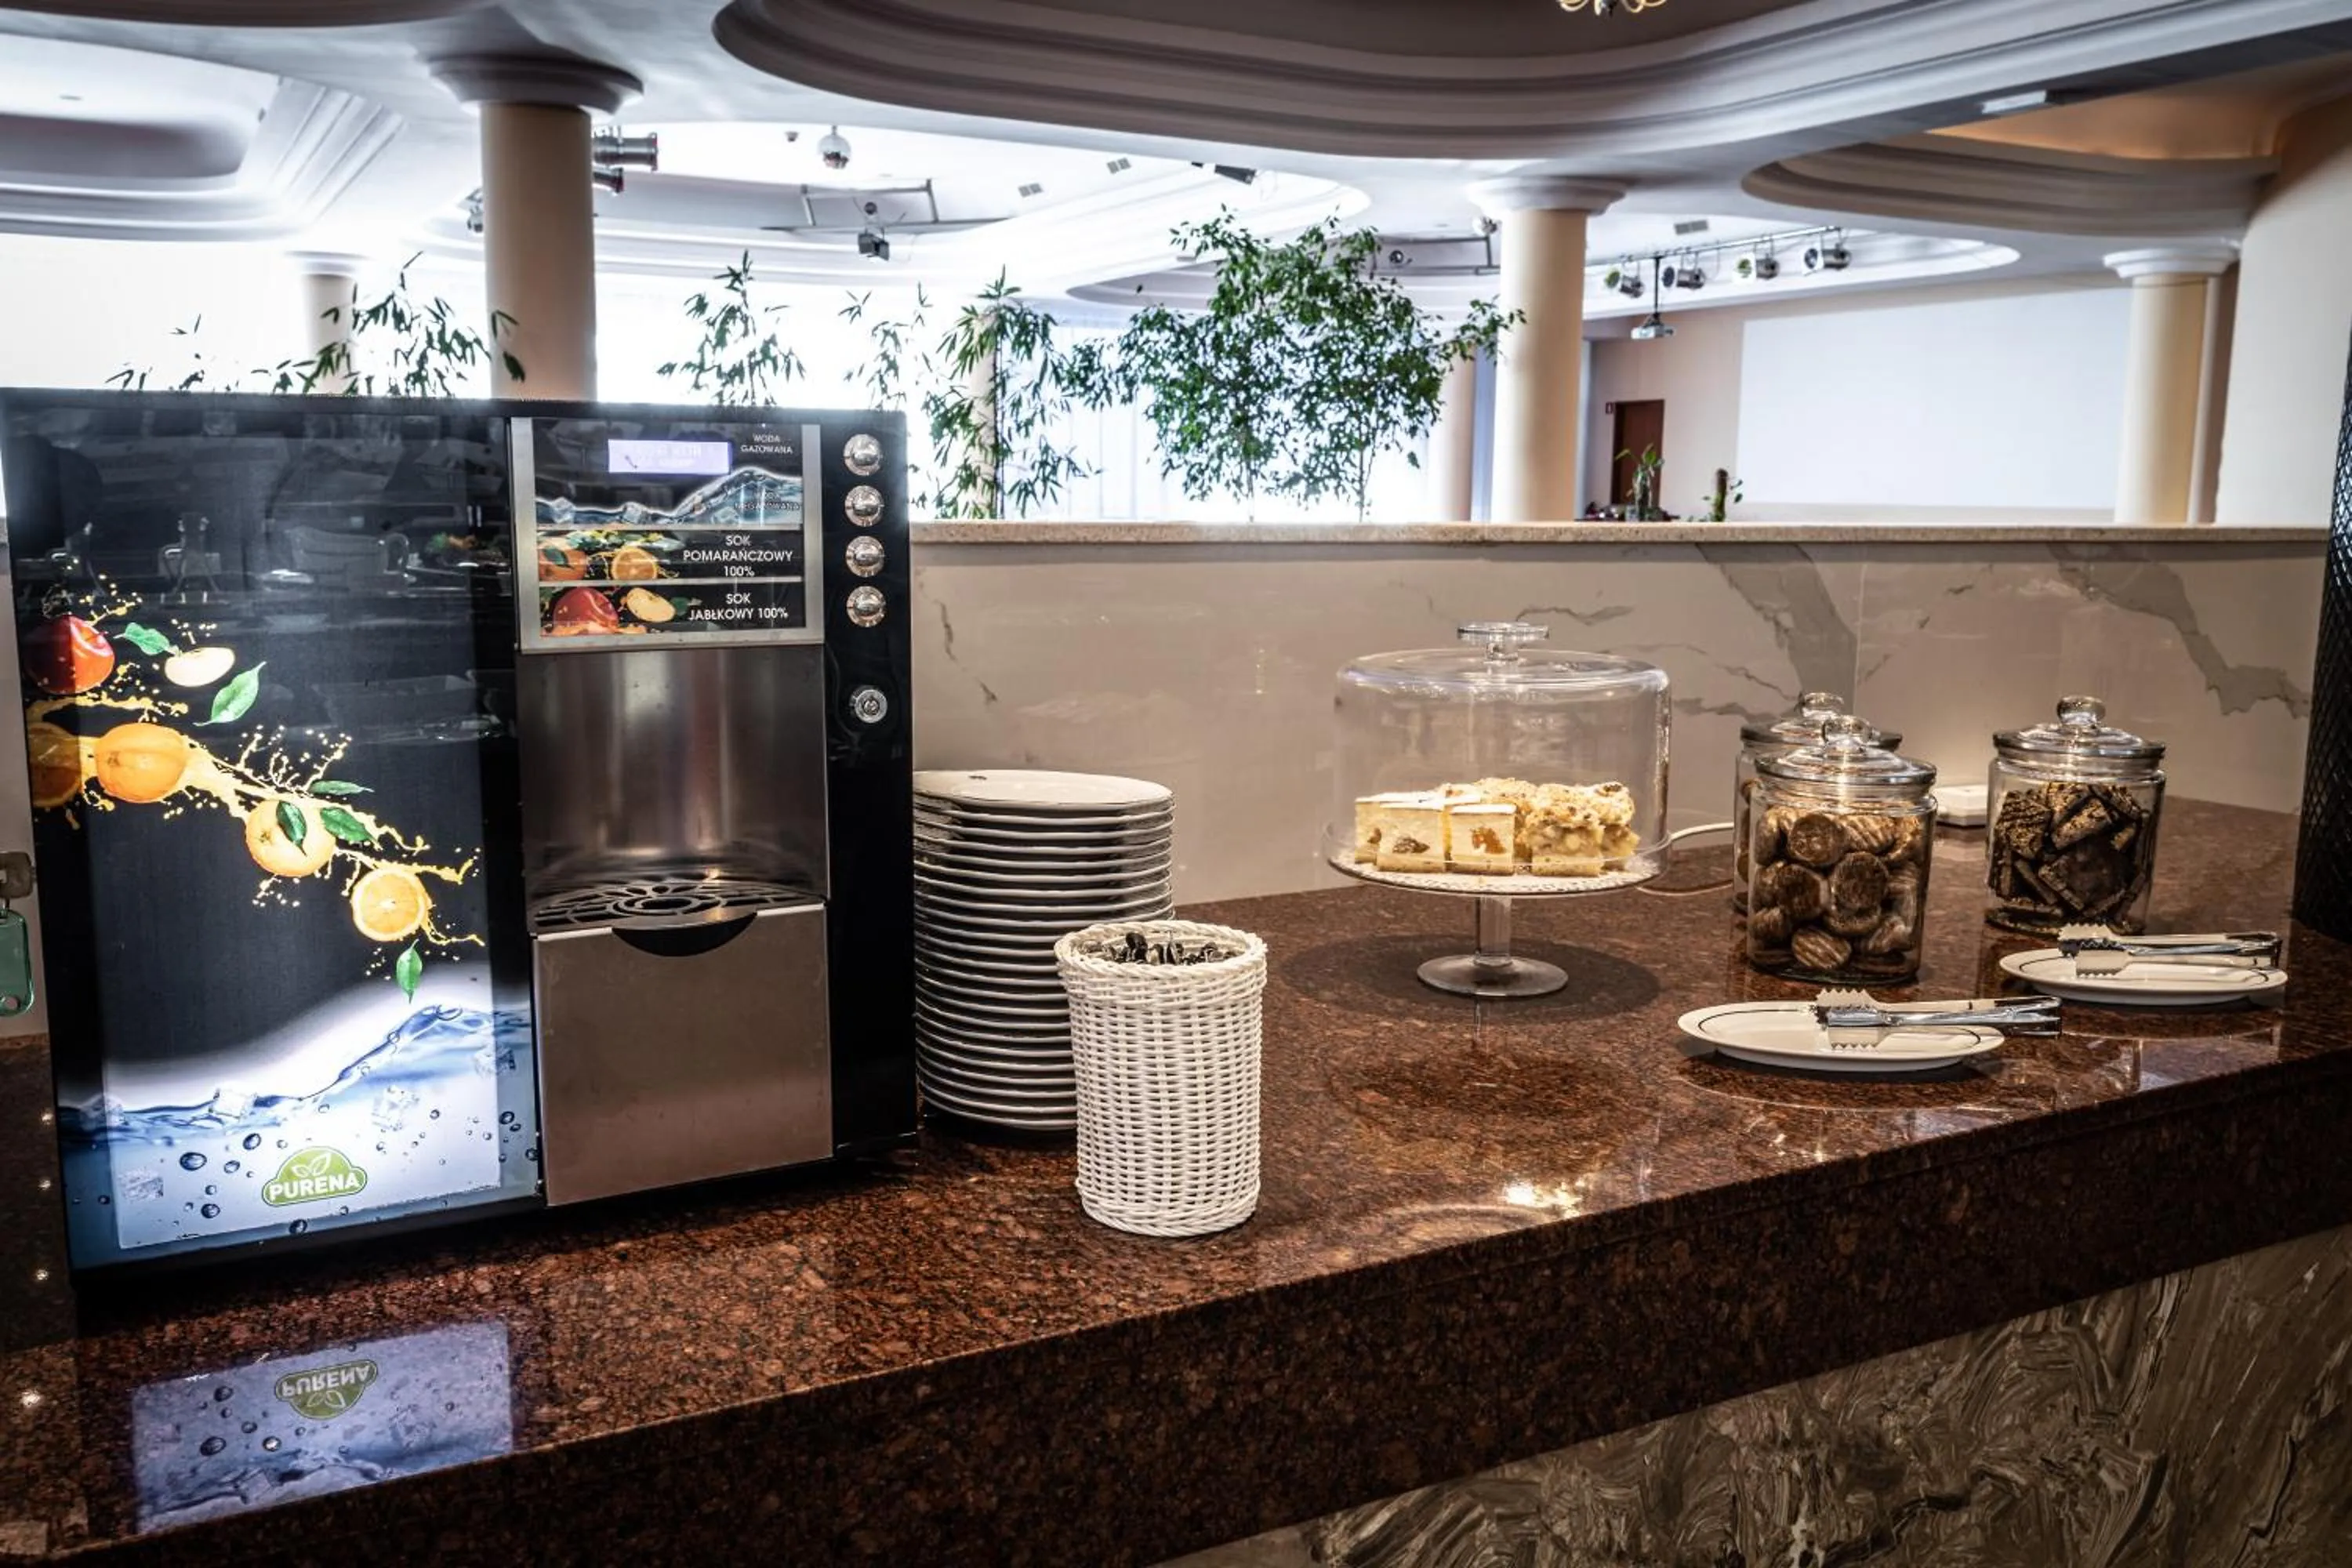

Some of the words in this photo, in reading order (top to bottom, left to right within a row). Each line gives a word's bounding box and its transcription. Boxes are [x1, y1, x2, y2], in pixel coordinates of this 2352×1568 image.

[740, 445, 793, 454] GAZOWANA
[725, 535, 752, 546] SOK
[683, 548, 793, 562] POMARAŃCZOWY
[724, 565, 755, 577] 100%
[726, 593, 752, 604] SOK
[688, 608, 753, 620] JABŁKOWY
[758, 607, 789, 619] 100%
[269, 1172, 360, 1202] PURENA
